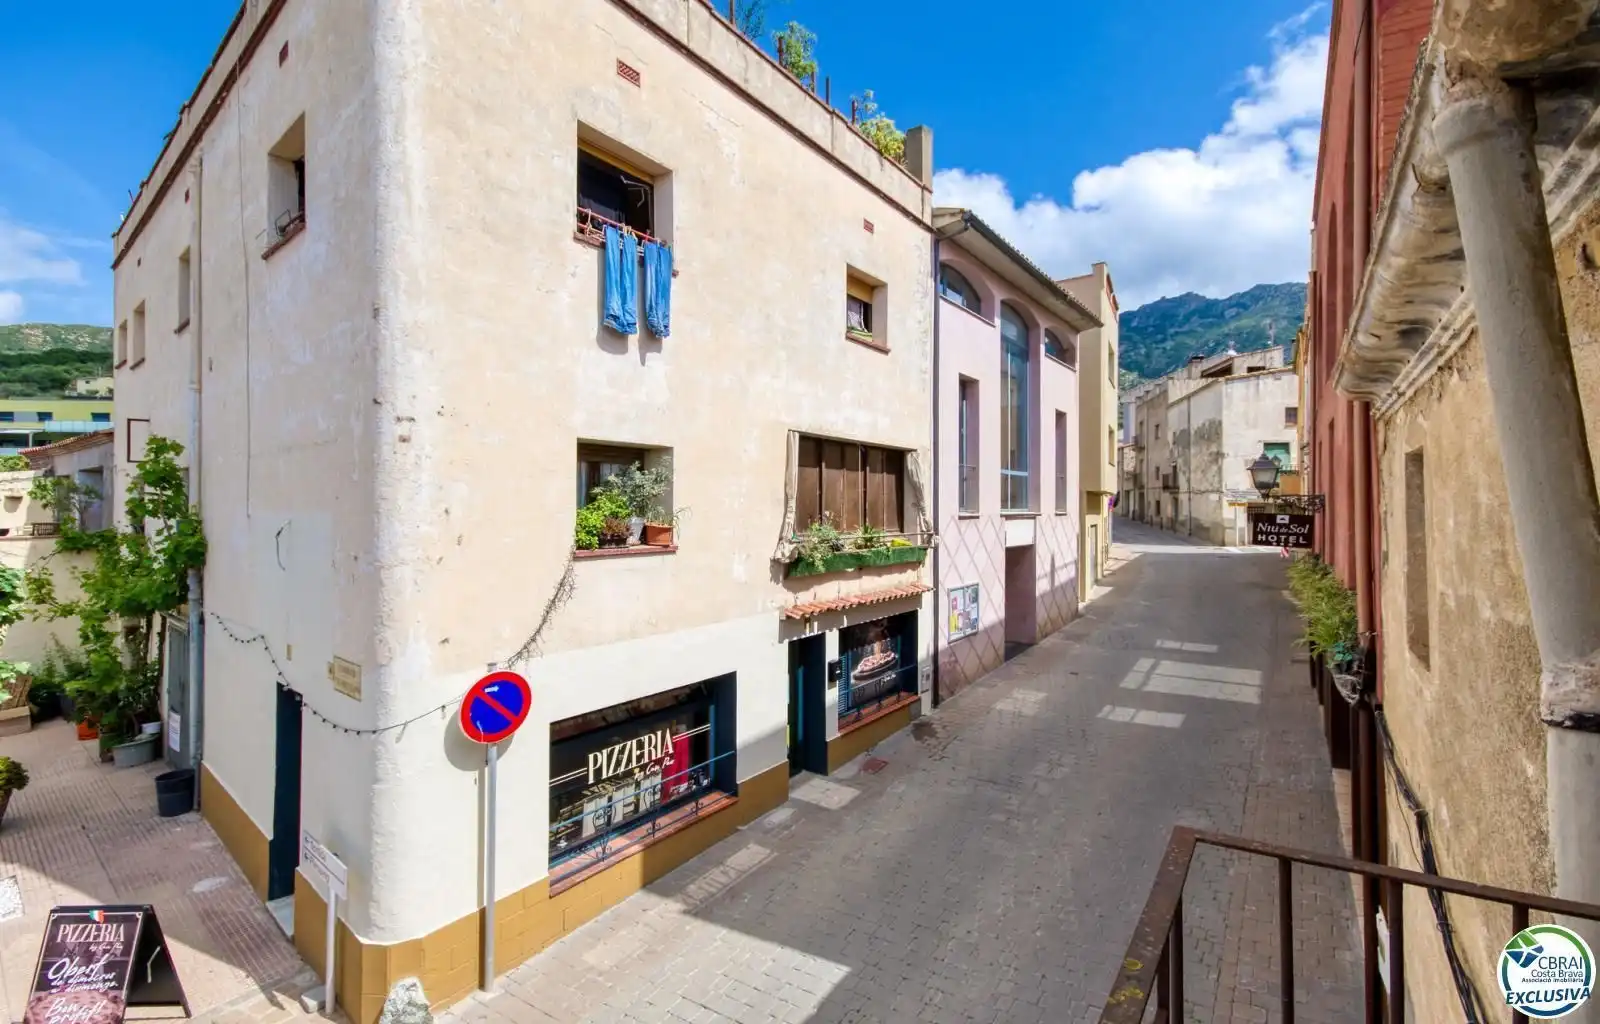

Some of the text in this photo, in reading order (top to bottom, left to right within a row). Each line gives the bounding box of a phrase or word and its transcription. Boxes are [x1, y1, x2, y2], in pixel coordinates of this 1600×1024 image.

[1289, 523, 1309, 534] Sol
[1257, 534, 1307, 544] HOTEL
[587, 728, 674, 785] PIZZERIA
[56, 924, 125, 943] PIZZERIA
[47, 953, 112, 980] Obert
